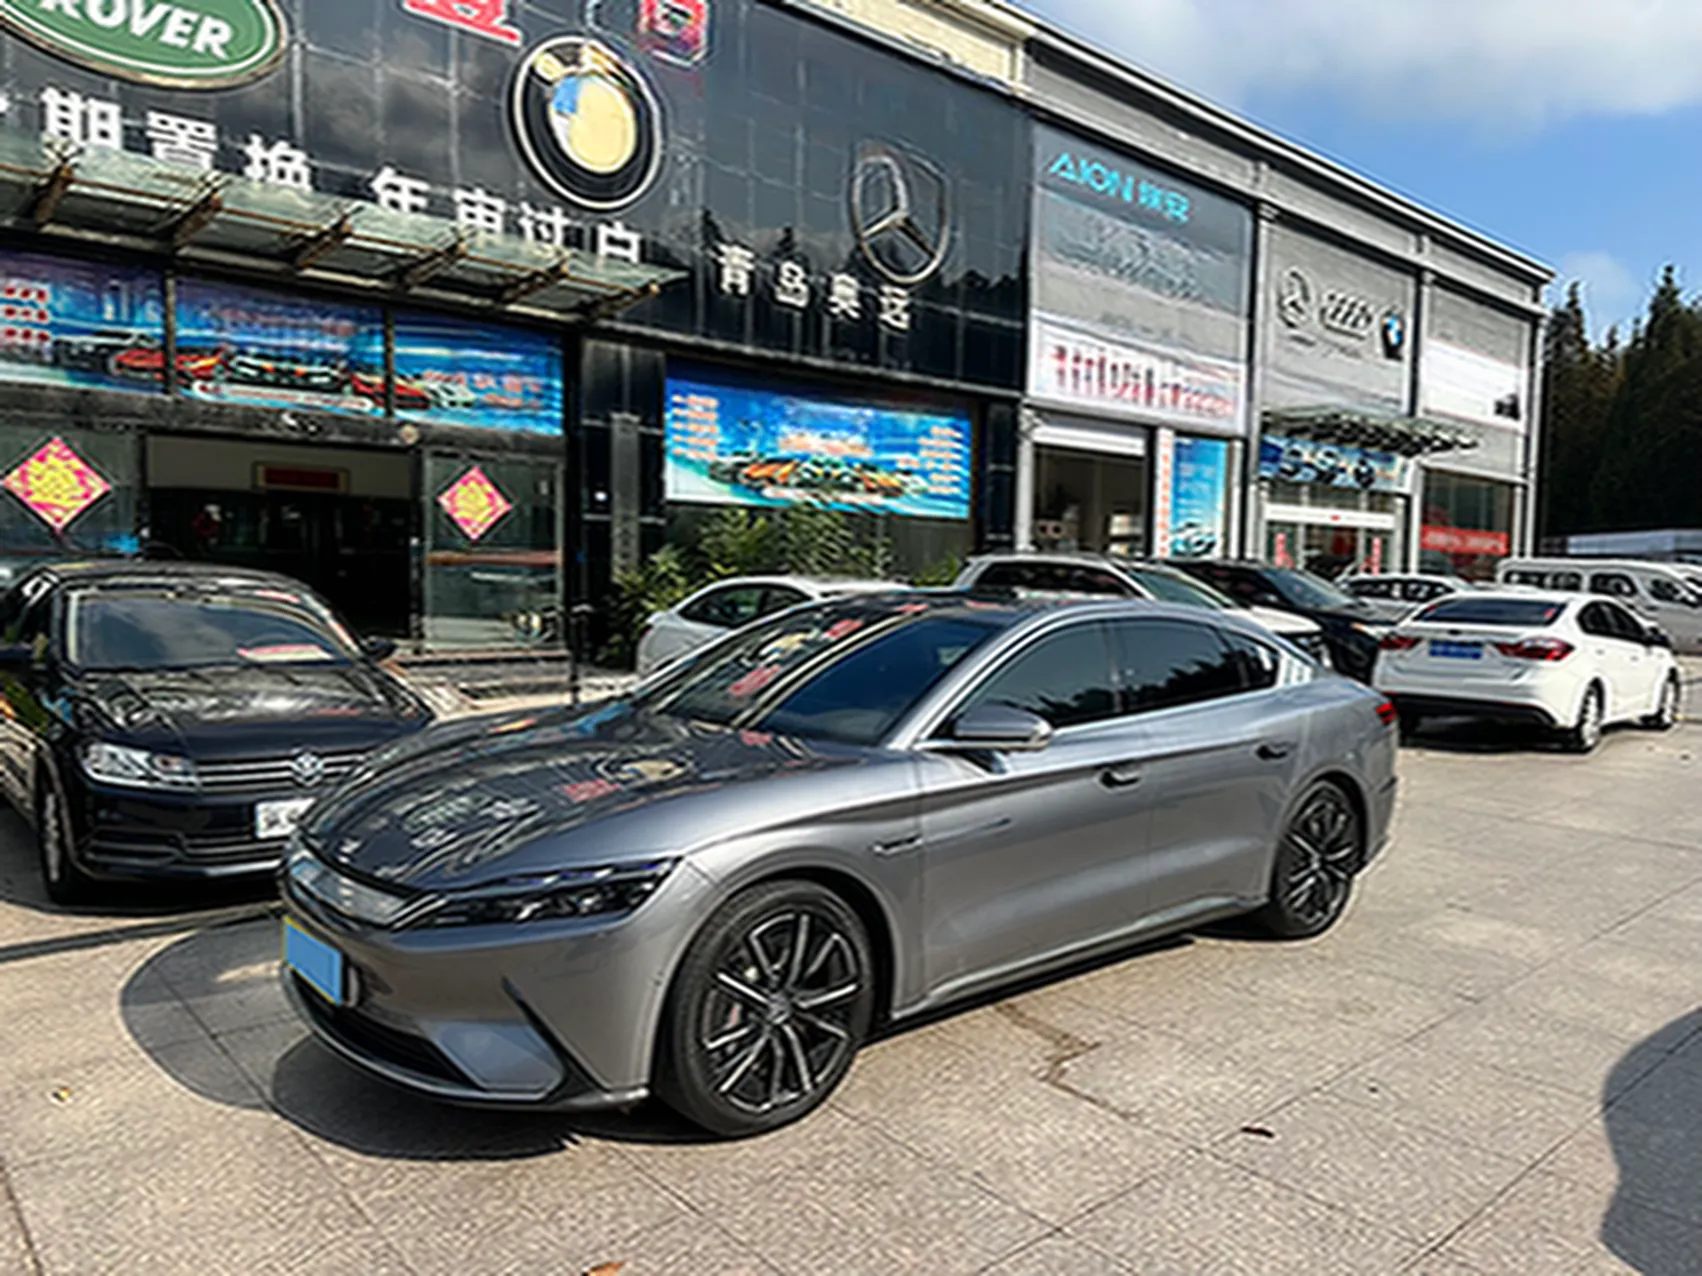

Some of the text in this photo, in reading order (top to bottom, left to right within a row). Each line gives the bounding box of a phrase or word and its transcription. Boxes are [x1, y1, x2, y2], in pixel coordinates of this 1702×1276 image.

[0, 86, 312, 193] 期置换
[1049, 153, 1135, 203] AION
